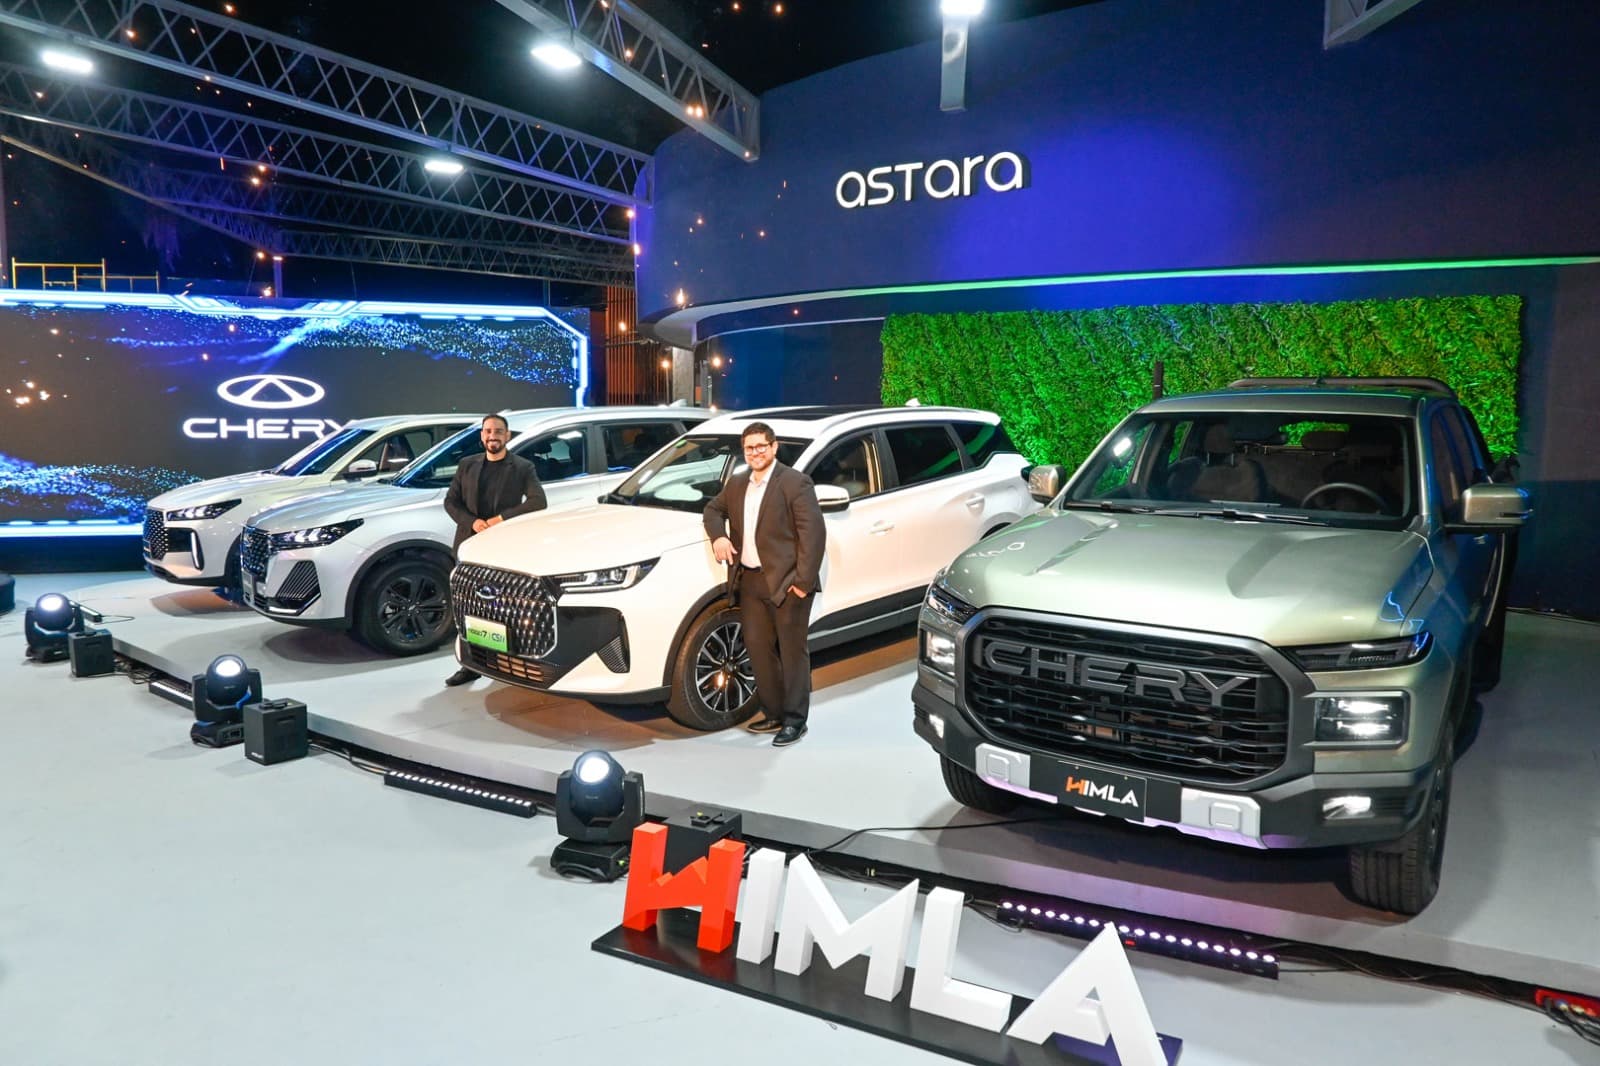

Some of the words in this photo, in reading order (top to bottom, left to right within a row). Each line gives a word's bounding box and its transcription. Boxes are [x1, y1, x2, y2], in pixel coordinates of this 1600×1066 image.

[984, 639, 1252, 708] CHERY
[1065, 775, 1139, 807] HIMLA
[622, 821, 1168, 1066] HIMLA
